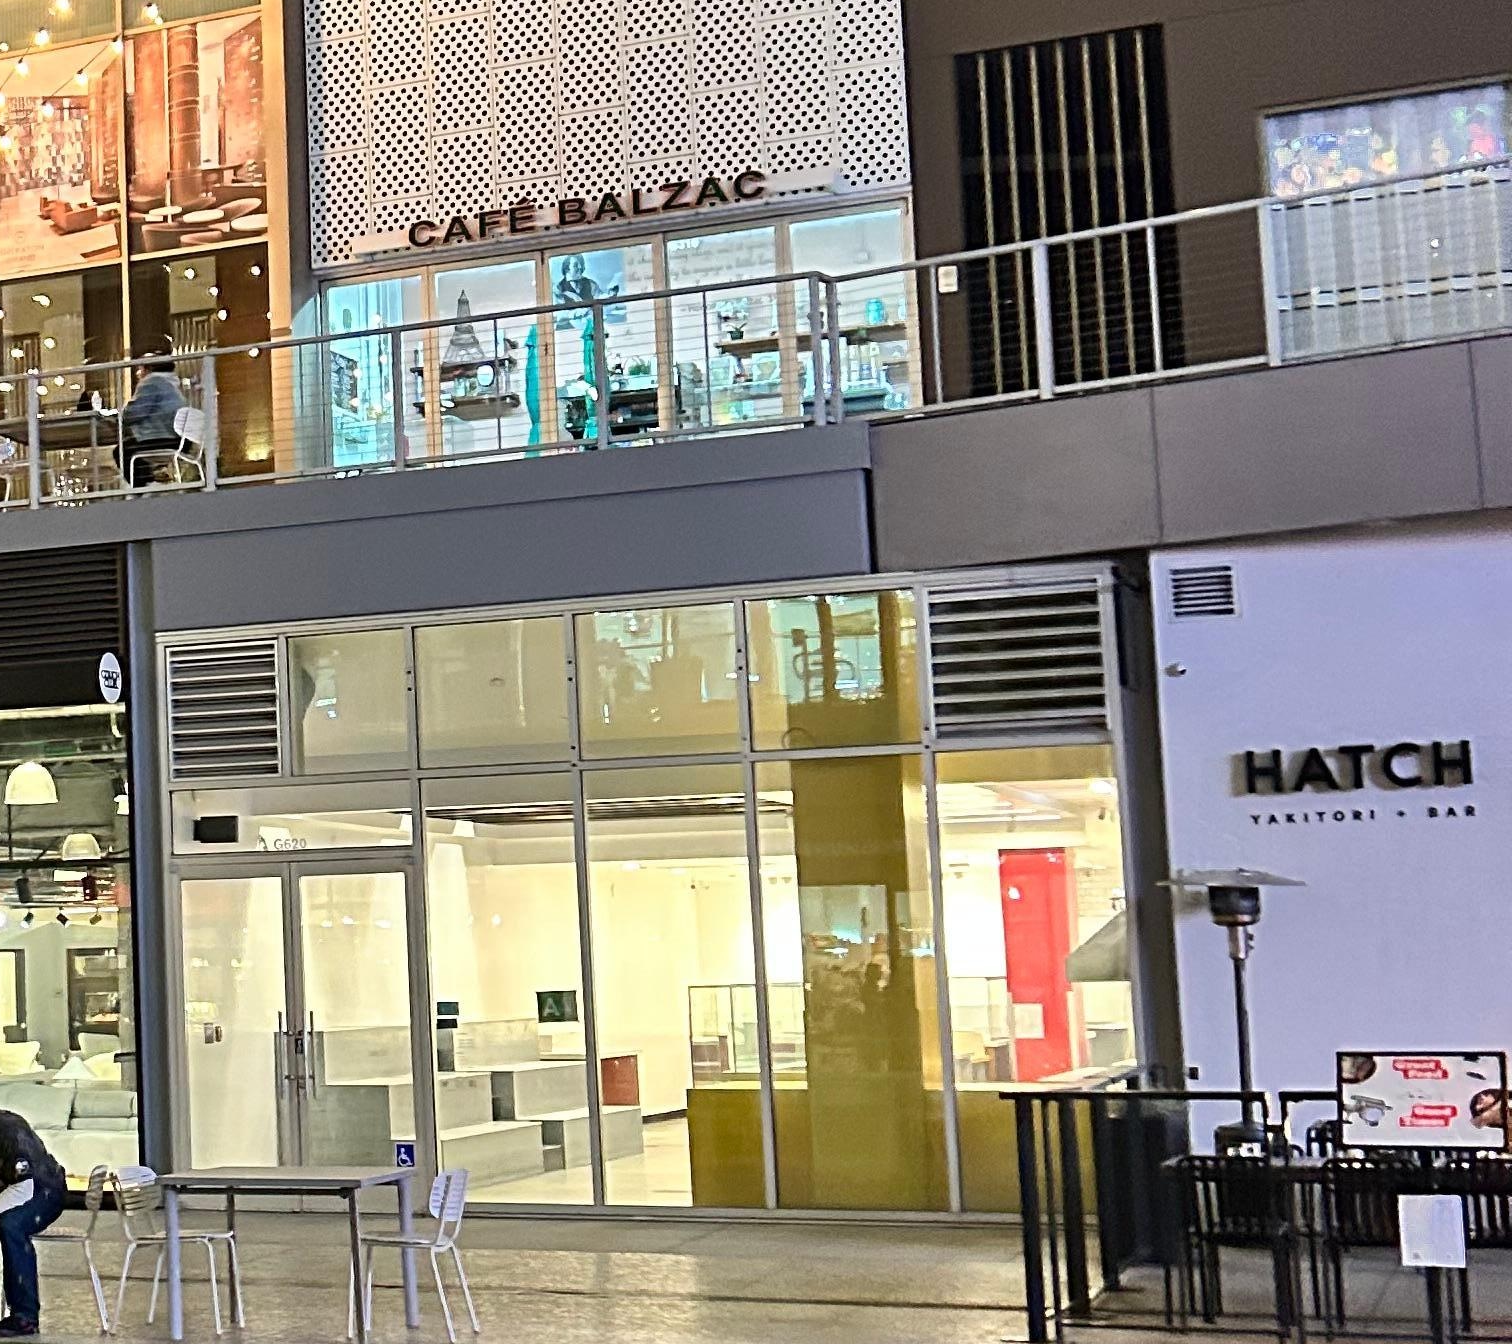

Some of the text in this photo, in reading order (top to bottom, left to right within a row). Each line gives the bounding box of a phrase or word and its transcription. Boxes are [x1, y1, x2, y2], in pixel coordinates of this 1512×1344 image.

[408, 170, 766, 248] CAFÉ BALZAC
[1238, 739, 1473, 794] HATCH
[1250, 809, 1376, 825] YAKITORI
[1428, 805, 1477, 819] BAR
[273, 838, 307, 850] G620
